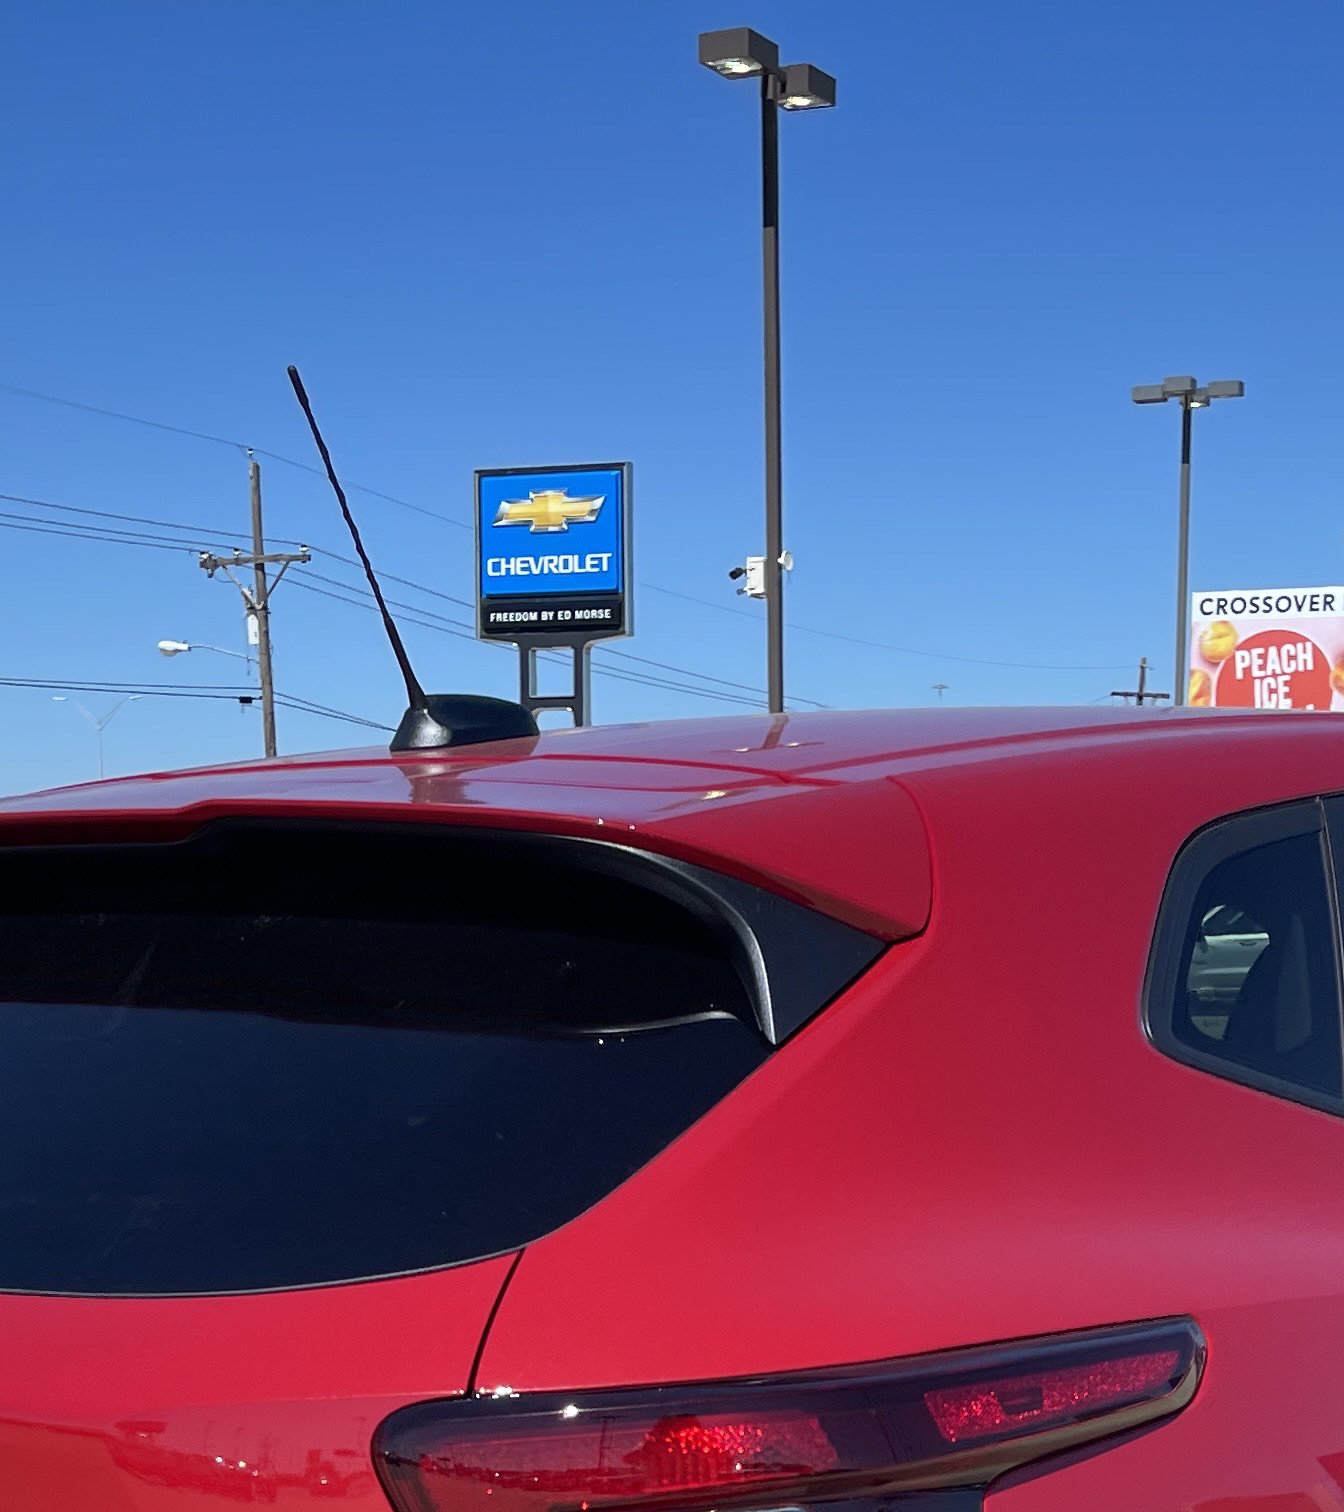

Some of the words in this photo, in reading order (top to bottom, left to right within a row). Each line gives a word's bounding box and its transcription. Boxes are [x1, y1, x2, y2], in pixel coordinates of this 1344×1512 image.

[487, 553, 613, 577] CHEVROLET
[490, 612, 538, 623] FREEDOM
[541, 611, 555, 621] BY
[558, 610, 572, 620] ED
[575, 609, 612, 620] MORSE
[1199, 594, 1336, 616] CROSSOVER
[1235, 641, 1315, 680] PEACH
[1253, 675, 1293, 709] ICE
